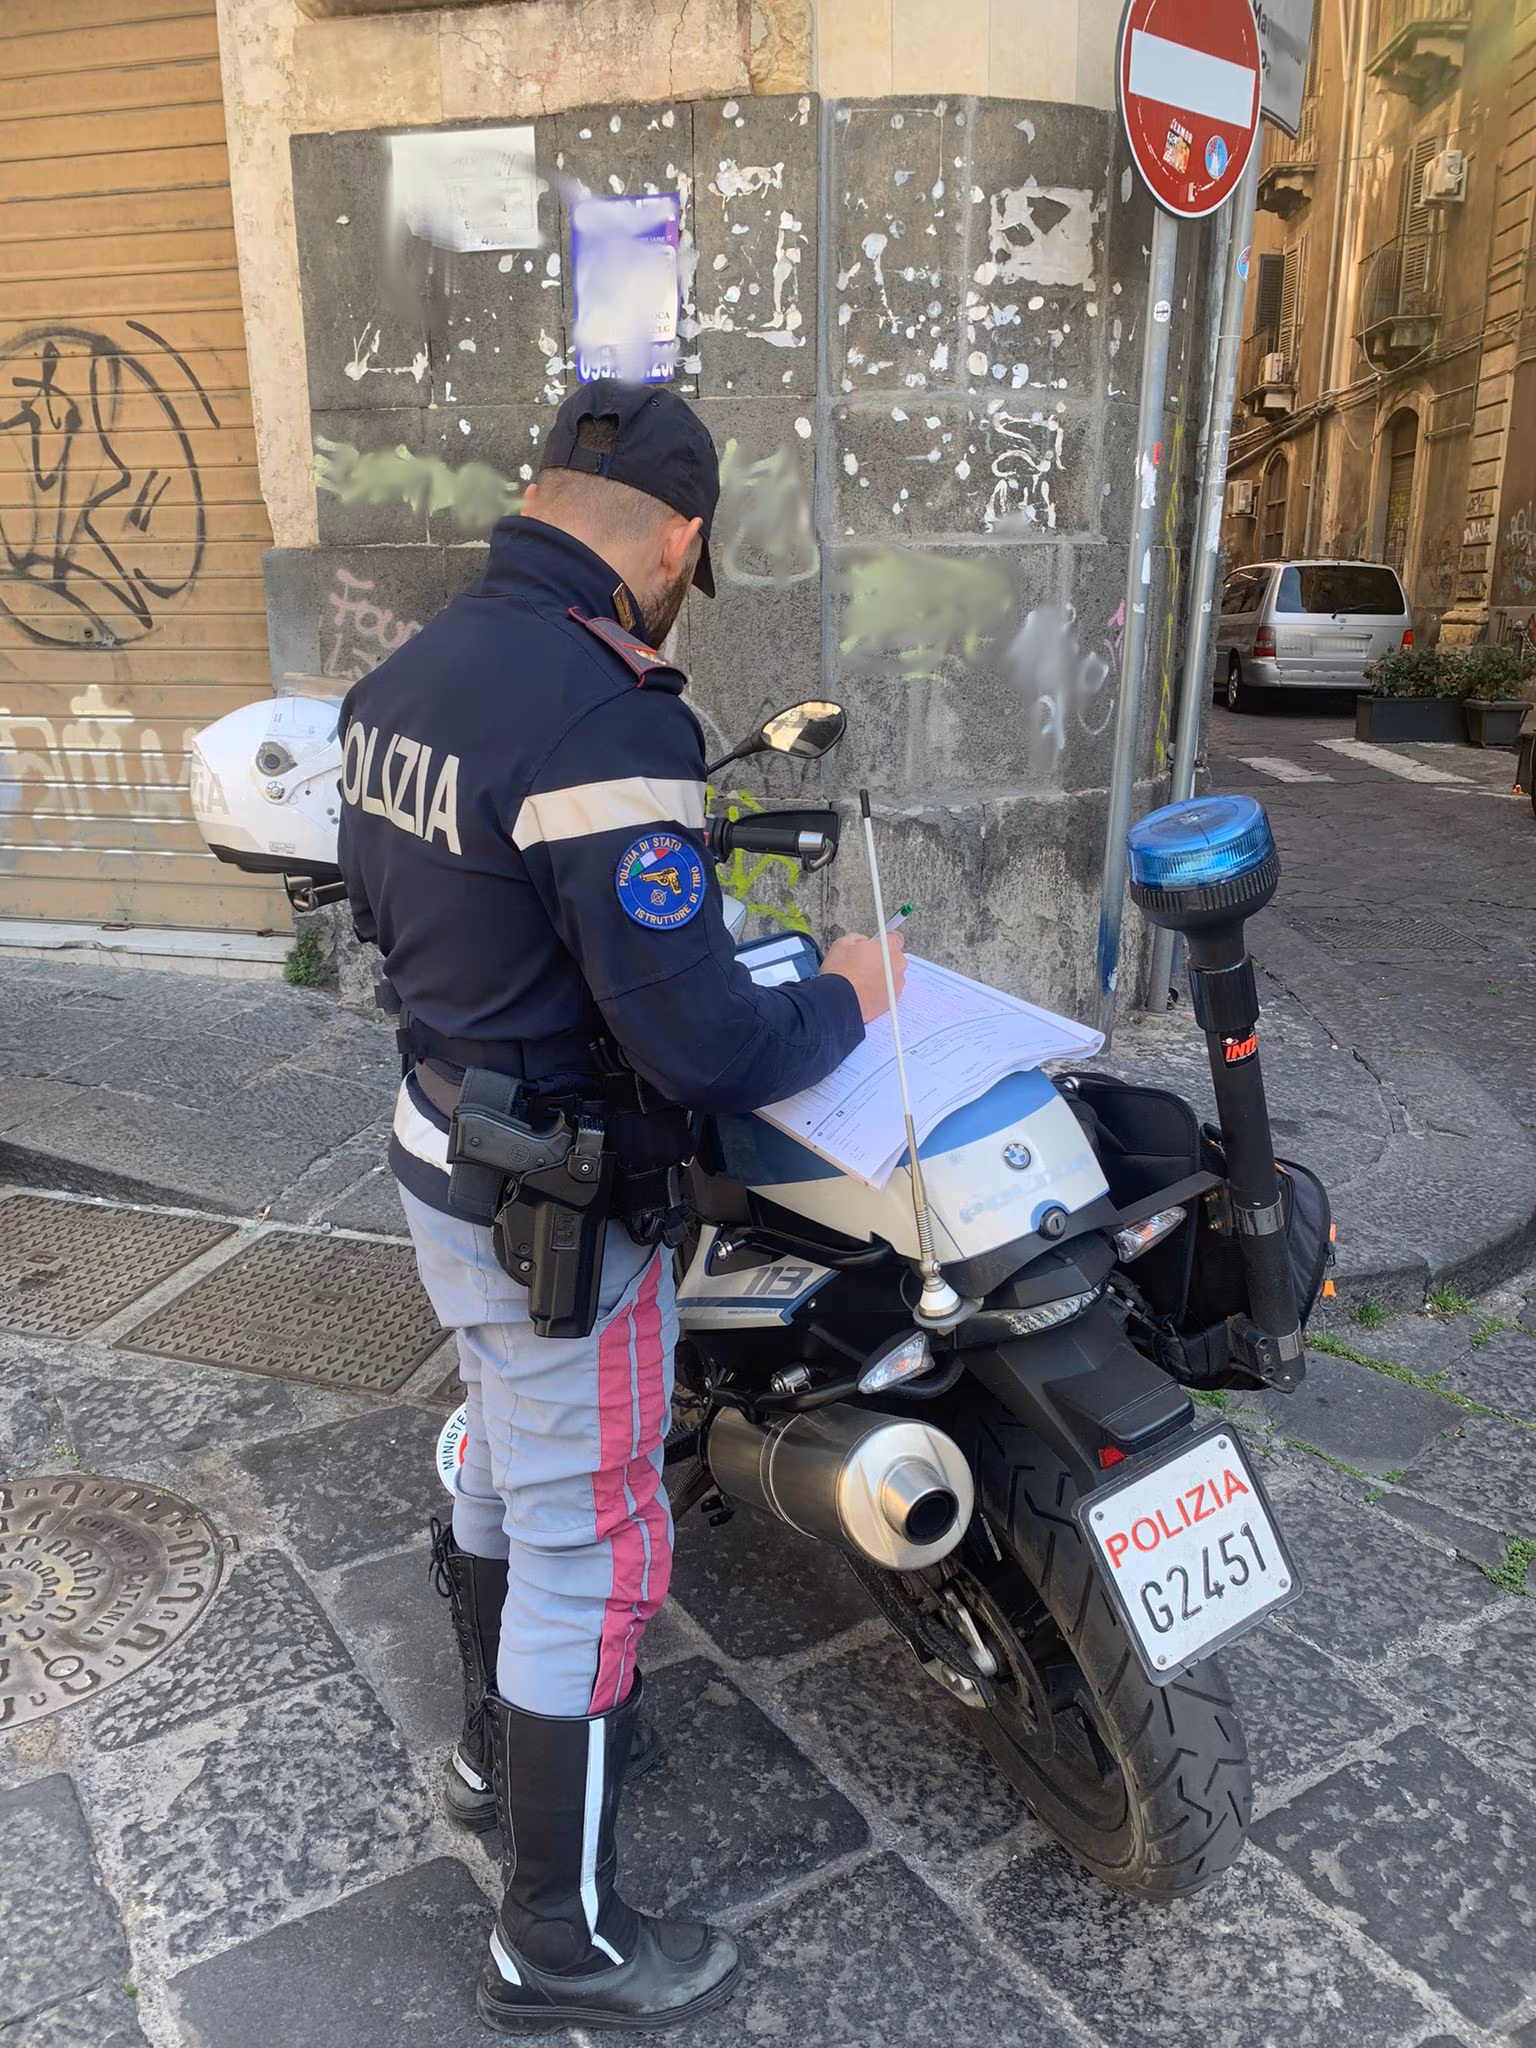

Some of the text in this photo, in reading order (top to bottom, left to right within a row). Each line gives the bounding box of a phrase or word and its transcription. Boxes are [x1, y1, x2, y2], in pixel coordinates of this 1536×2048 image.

[342, 715, 462, 855] OLIZIA
[620, 837, 682, 887] POLIZIA DI STATO
[634, 865, 701, 925] ISTRUTTORE DI TIRO
[743, 1266, 813, 1296] 113
[442, 1409, 467, 1471] MINISTE
[1104, 1468, 1250, 1569] POLIZIA
[82, 1573, 148, 1636] CATANIA
[1139, 1522, 1267, 1633] G2451
